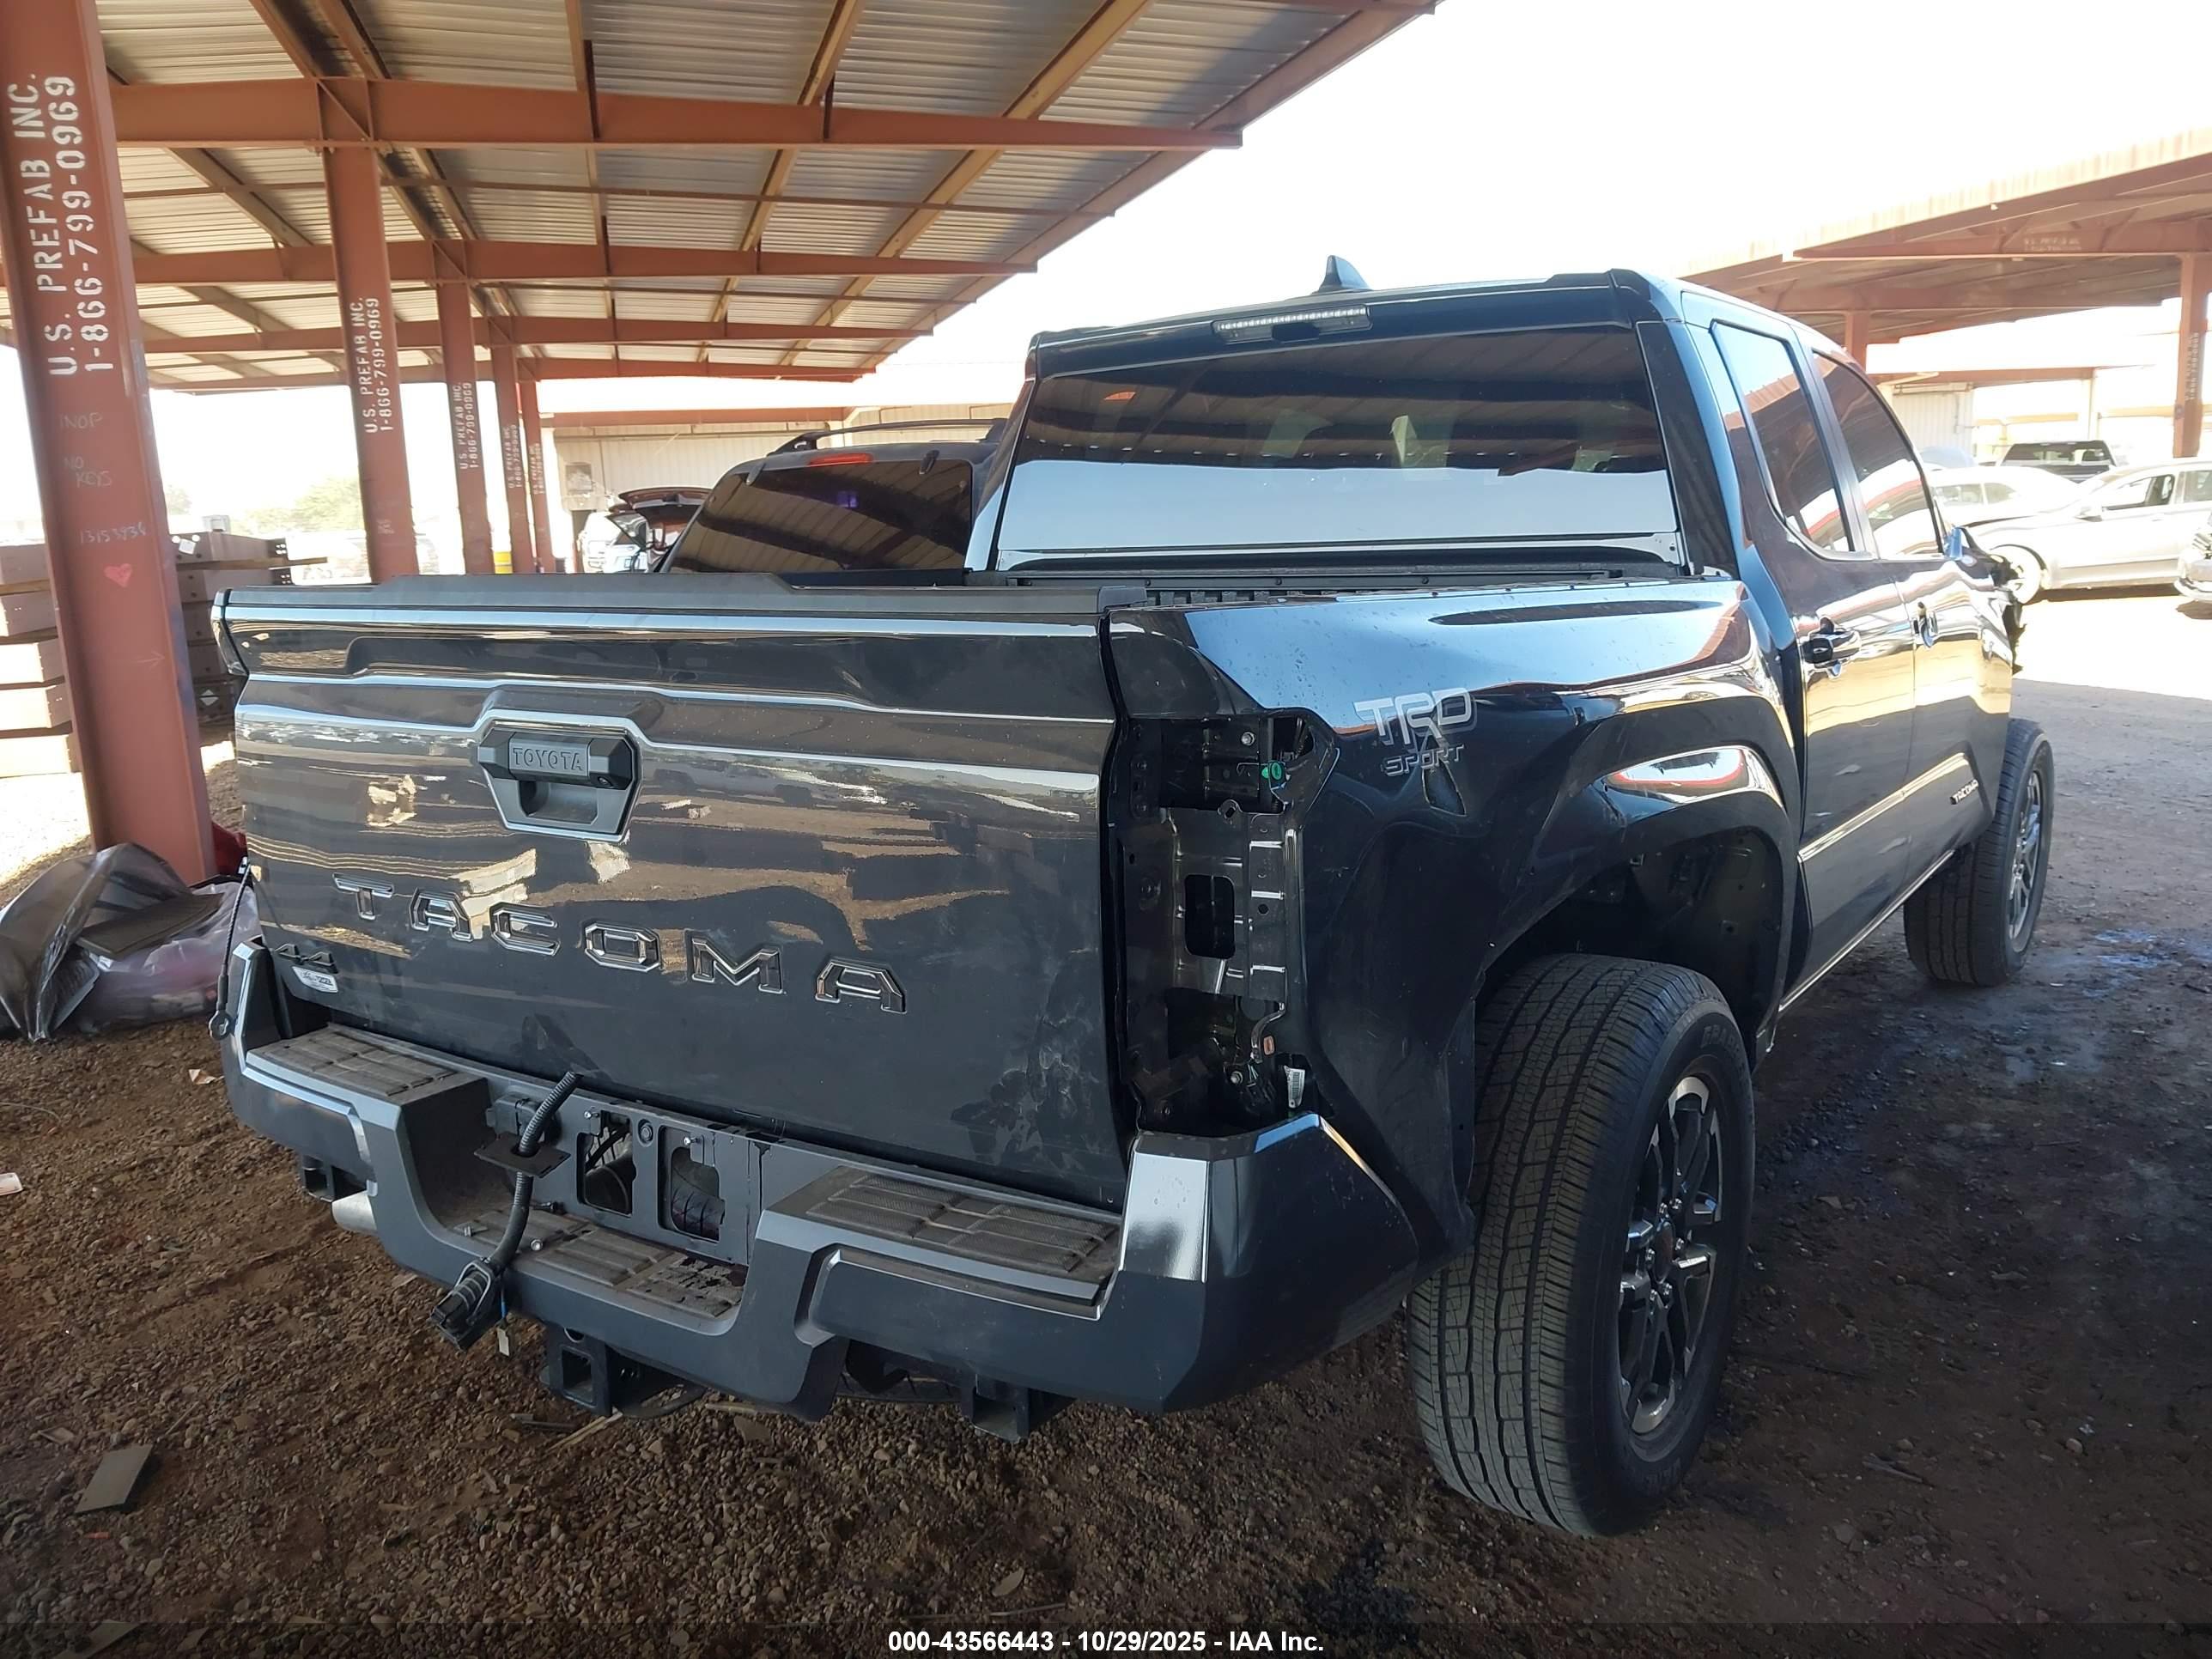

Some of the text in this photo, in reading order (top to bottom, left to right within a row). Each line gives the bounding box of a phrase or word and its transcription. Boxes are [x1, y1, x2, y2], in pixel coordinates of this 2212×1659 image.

[7, 74, 78, 375] U.S. PREFAB INC.
[44, 76, 114, 372] 1-866-799-0969
[349, 297, 379, 433] U.S. PREFAB INC.
[365, 297, 394, 431] 1-866-799-0969
[512, 748, 584, 772] TOYOTA
[1353, 687, 1472, 745] TRD
[1383, 744, 1465, 777] SPORT
[331, 872, 908, 1015] TACOMA
